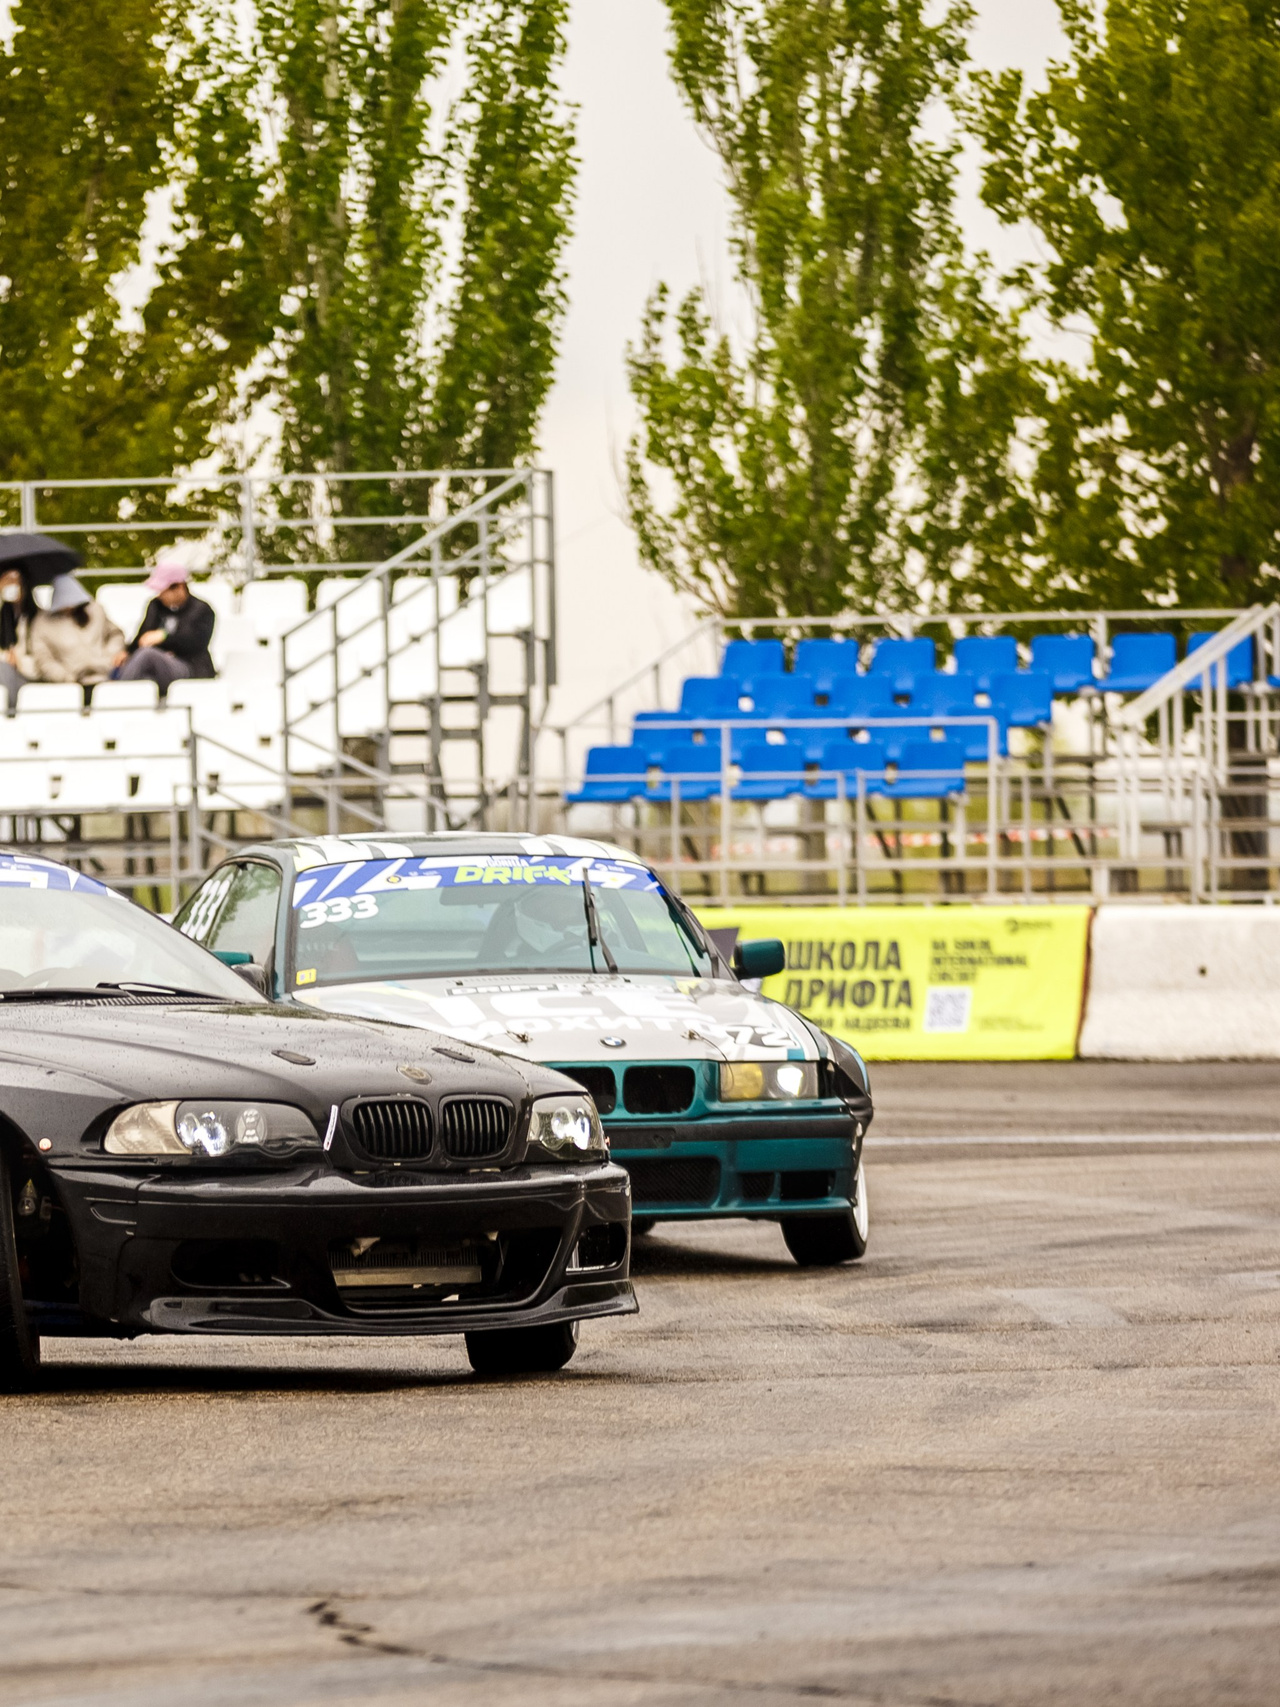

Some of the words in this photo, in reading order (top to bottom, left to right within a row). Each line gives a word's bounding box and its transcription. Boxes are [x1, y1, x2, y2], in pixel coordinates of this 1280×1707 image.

[454, 865, 571, 885] DRIFT
[300, 894, 379, 929] 333
[785, 940, 902, 971] ШКОЛА
[784, 979, 913, 1010] ДРИФТА
